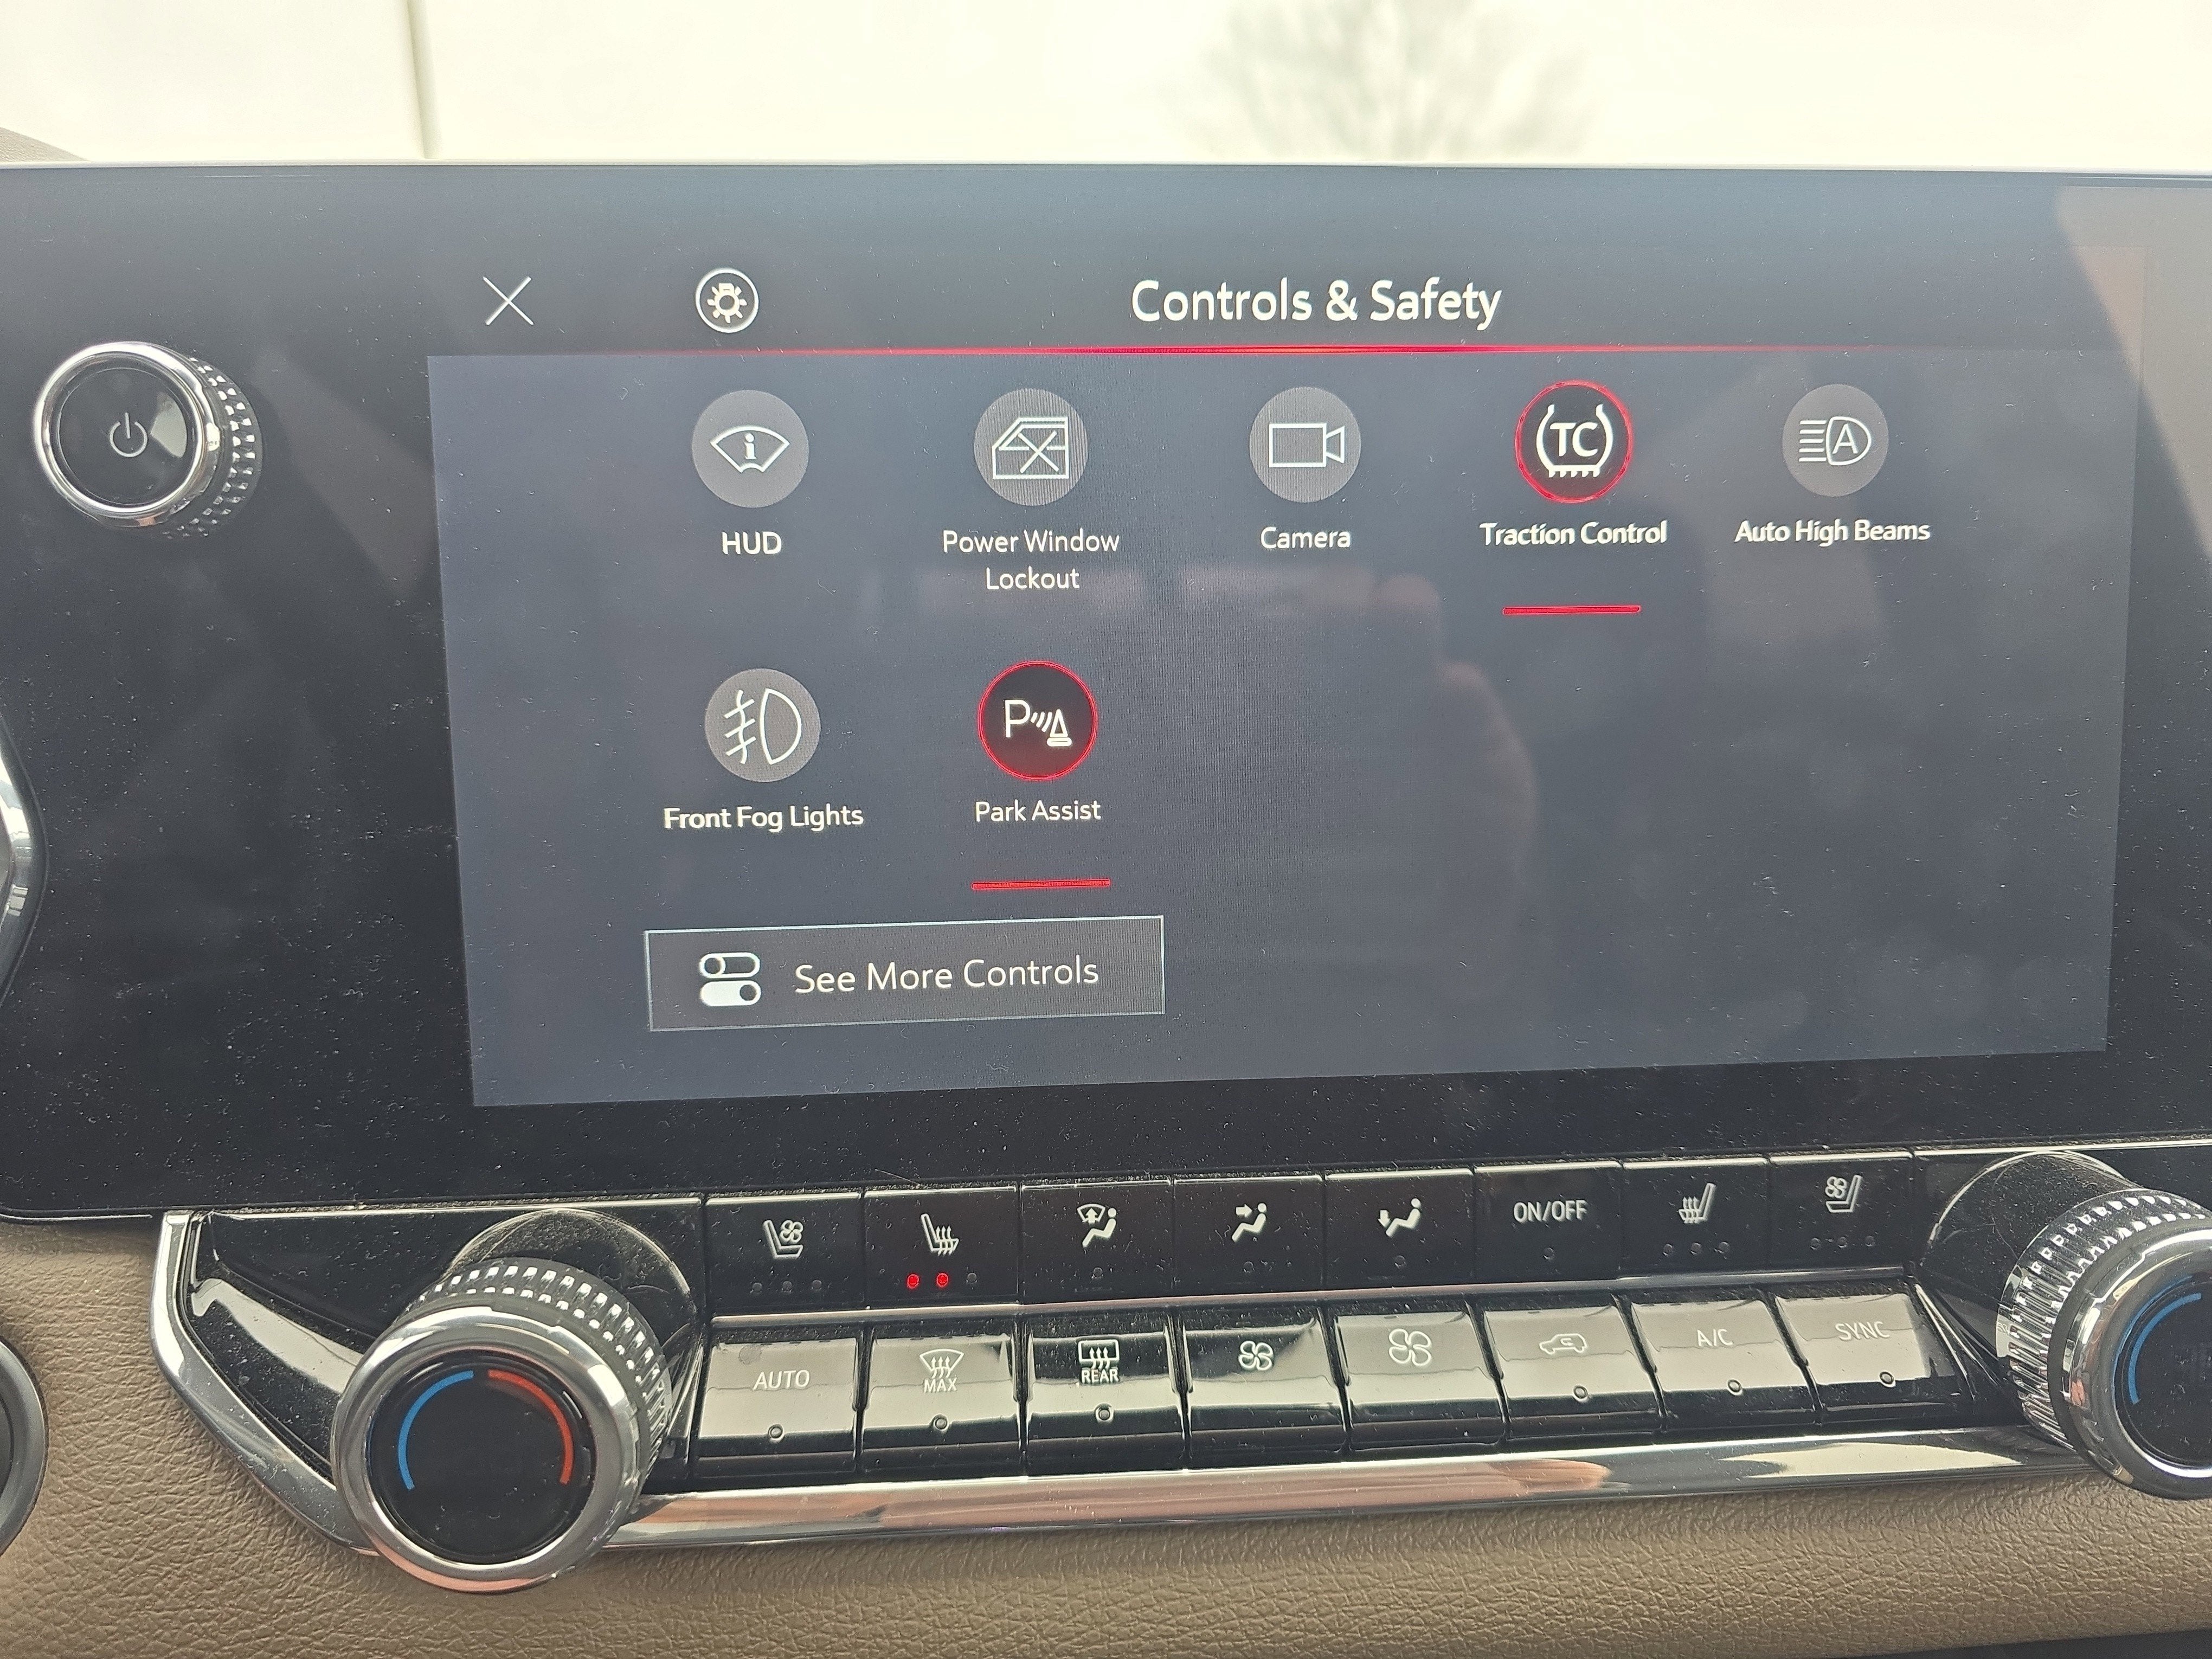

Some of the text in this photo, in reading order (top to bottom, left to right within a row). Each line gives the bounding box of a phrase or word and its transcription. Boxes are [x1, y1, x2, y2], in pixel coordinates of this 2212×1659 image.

[1131, 276, 1502, 331] Controls & Safety
[1550, 422, 1599, 458] TC
[1832, 423, 1859, 454] A
[722, 531, 782, 555] HUD
[943, 528, 1120, 553] Power Window
[1261, 526, 1351, 549] Camera
[1479, 520, 1668, 545] Traction Control
[1734, 518, 1931, 547] Auto High Beams
[986, 567, 1081, 590] Lockout
[1005, 699, 1031, 738] P
[663, 803, 864, 832] Front Fog Lights
[976, 799, 1102, 822] Park Assist
[795, 954, 1099, 994] See More Controls
[1513, 1200, 1587, 1223] ON/OFF
[1697, 1328, 1733, 1347] A/C
[1835, 1320, 1891, 1341] SYNC
[754, 1369, 811, 1390] AUTO
[924, 1379, 957, 1393] MAX
[1081, 1367, 1119, 1384] REAR
